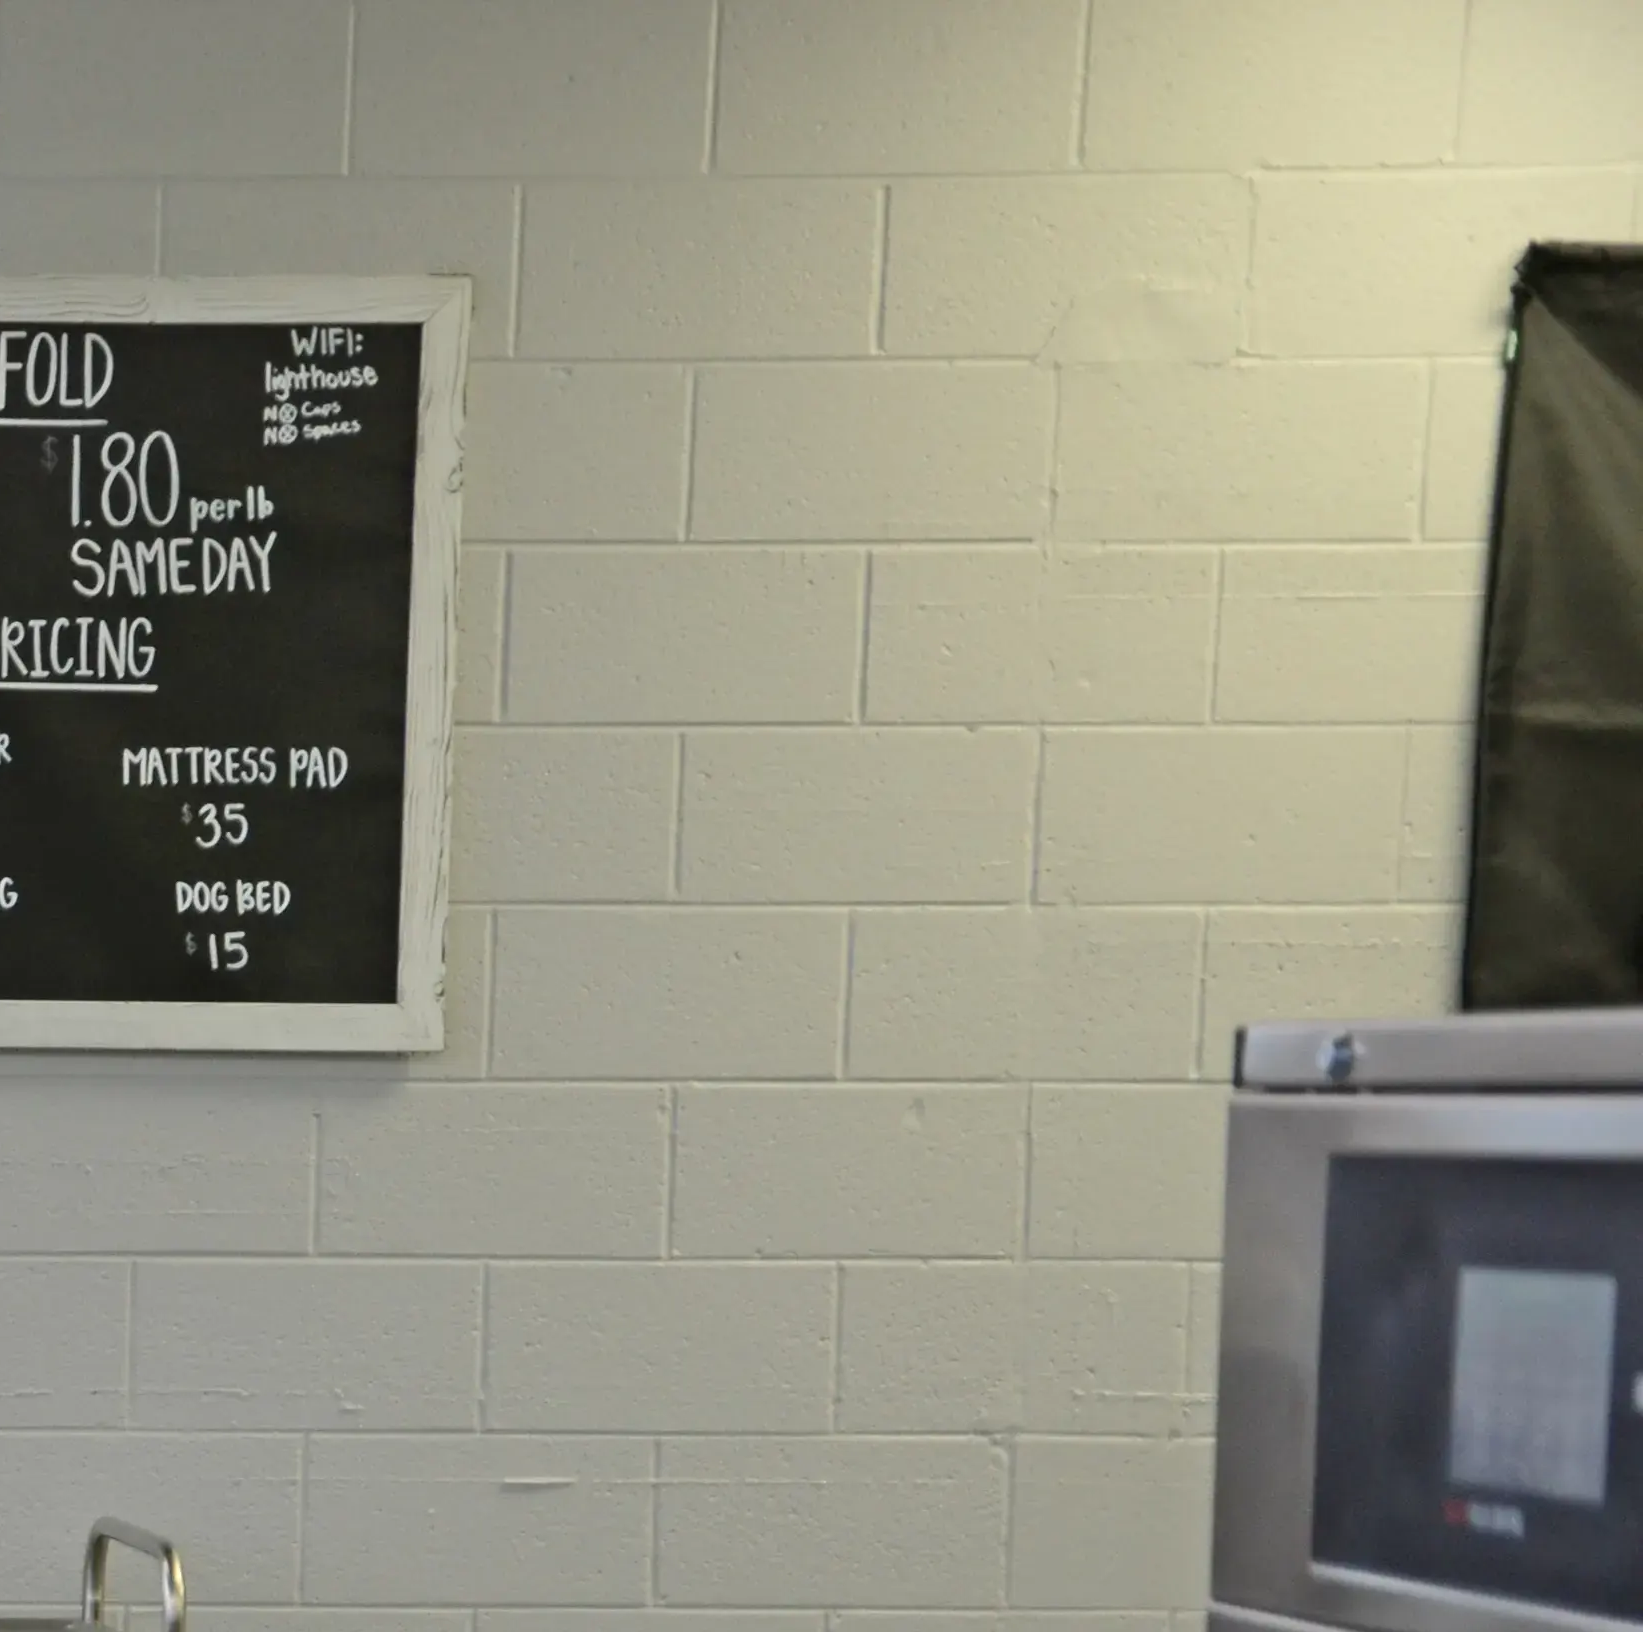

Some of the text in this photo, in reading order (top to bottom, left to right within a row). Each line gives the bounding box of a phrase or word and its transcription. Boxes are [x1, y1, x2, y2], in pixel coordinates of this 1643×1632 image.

[290, 325, 364, 357] WIFI:
[264, 360, 379, 402] lighthouse
[189, 497, 243, 534] per
[246, 485, 275, 521] lb
[70, 531, 278, 598] SAME DAY
[121, 745, 349, 789] MATTRESS PAD
[174, 877, 292, 916] DOG BED
